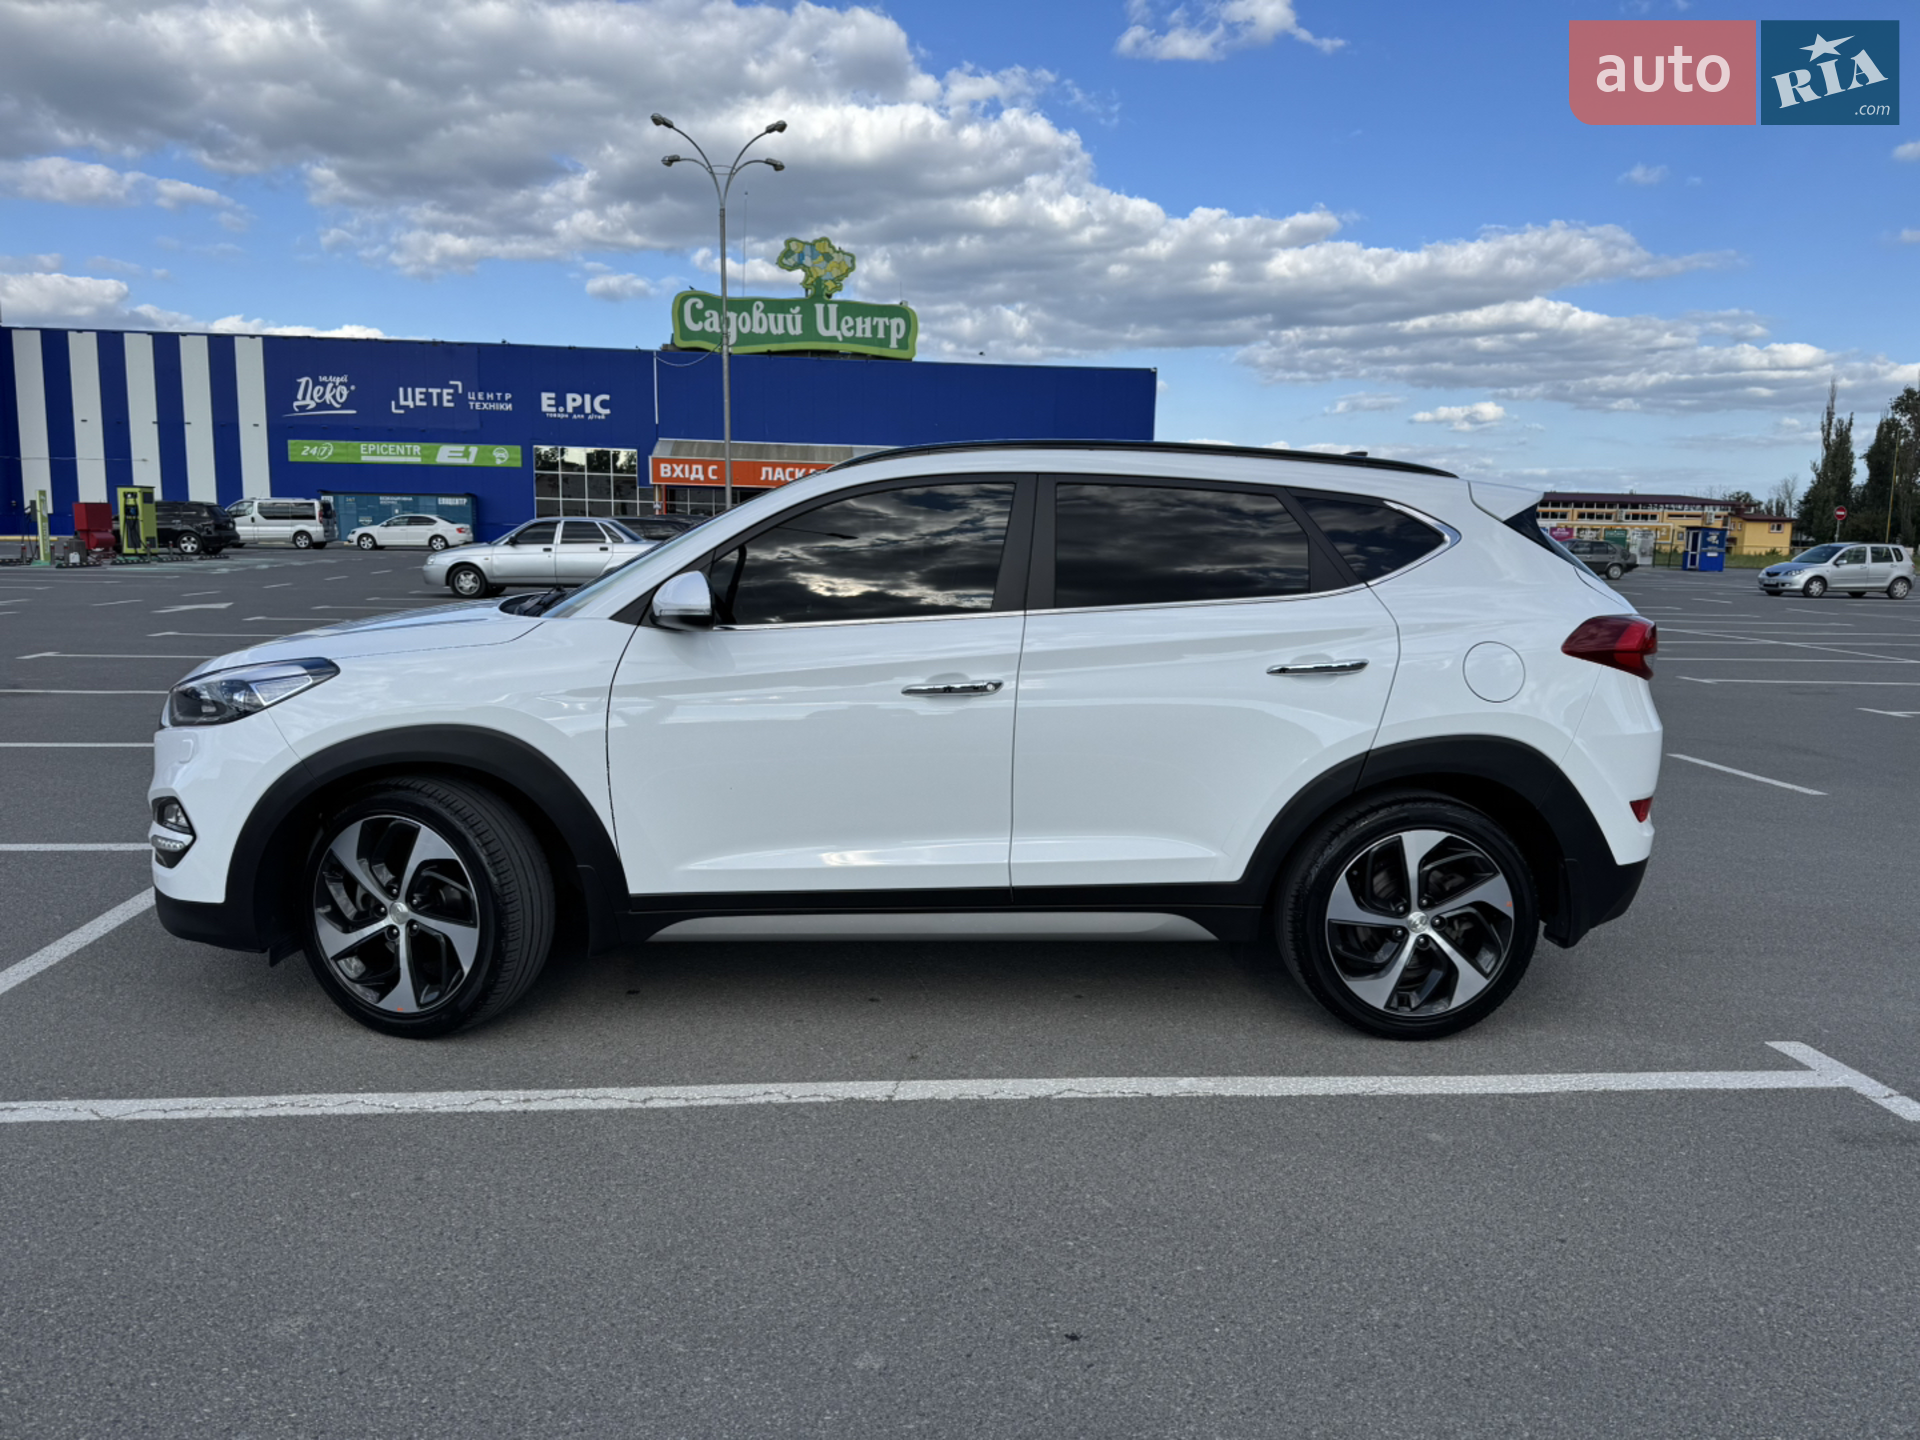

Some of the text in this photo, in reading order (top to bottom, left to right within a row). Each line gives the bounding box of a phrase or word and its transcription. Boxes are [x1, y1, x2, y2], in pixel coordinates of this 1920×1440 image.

[683, 297, 906, 349] Садовий Центр
[293, 376, 350, 412] Деко
[399, 387, 455, 408] ЦЕТЕ
[467, 391, 512, 401] ЦЕНТР
[541, 392, 611, 415] E.PIC
[468, 402, 513, 411] ТЕХНІКИ
[360, 444, 422, 456] EPICENTR
[660, 463, 704, 481] ВХІД
[760, 466, 816, 482] ЛАСК
